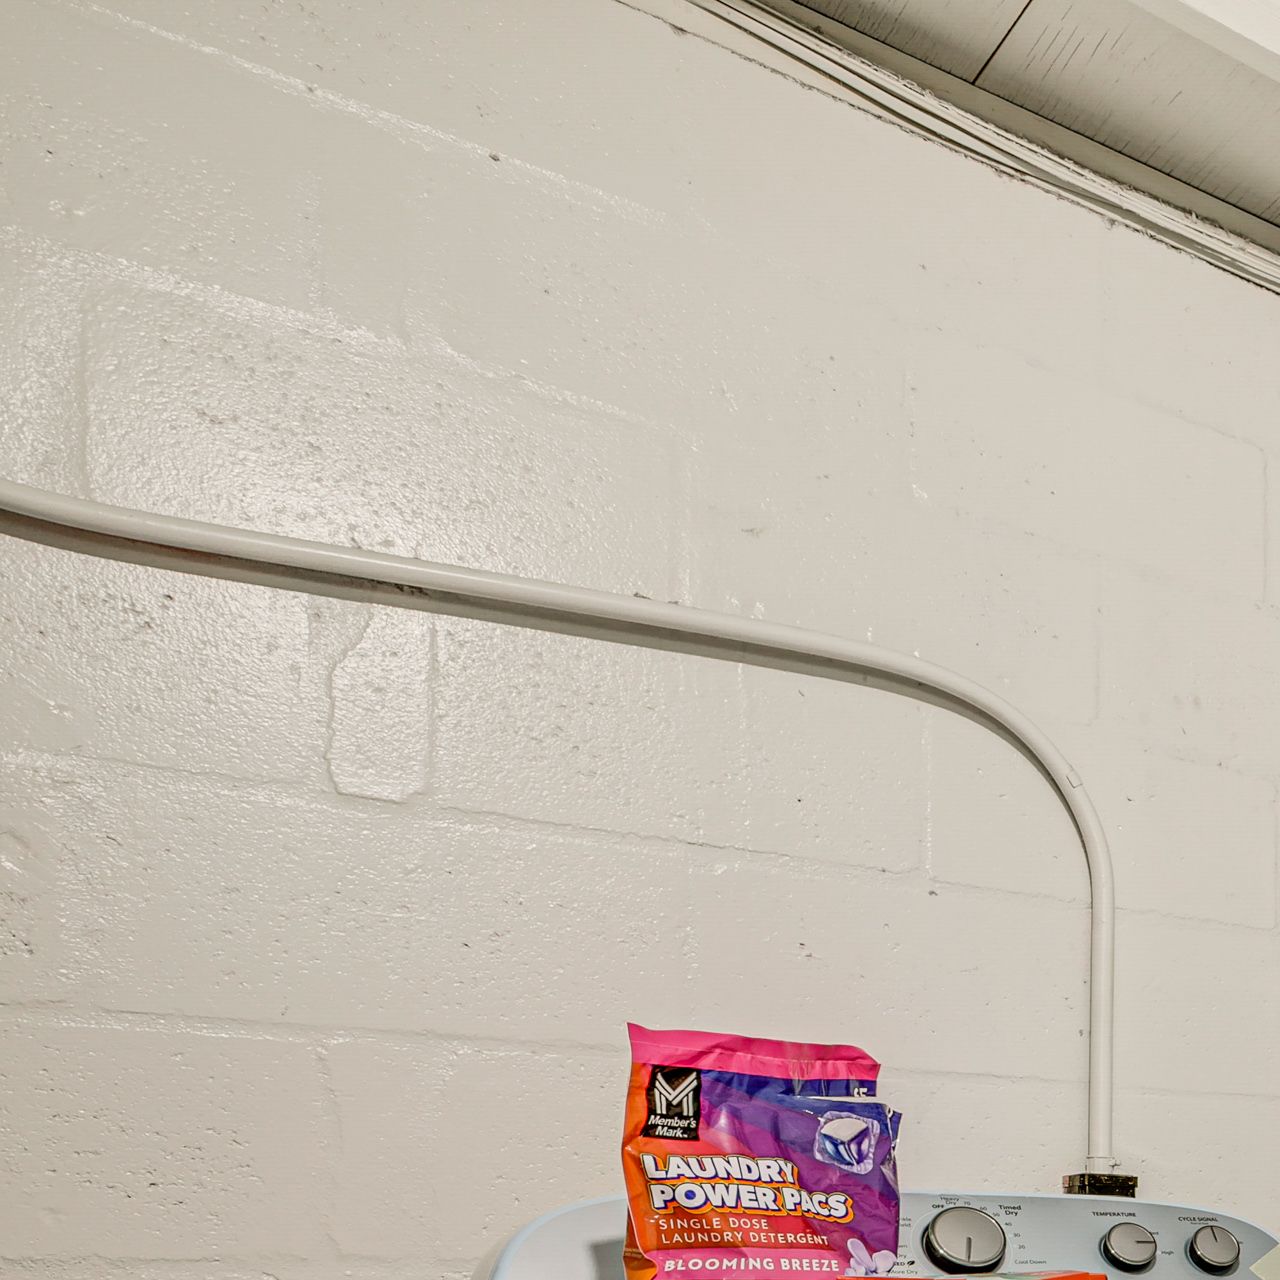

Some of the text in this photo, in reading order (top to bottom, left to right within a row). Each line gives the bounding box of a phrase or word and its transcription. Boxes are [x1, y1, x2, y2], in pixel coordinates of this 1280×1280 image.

[648, 1115, 697, 1129] Member's
[641, 1154, 798, 1184] LAUNDRY
[650, 1183, 849, 1219] POWER PACS
[659, 1217, 769, 1230] SINGLE DOSE
[661, 1231, 829, 1246] LAUNDRY DETERGENT
[664, 1258, 840, 1272] BLOOMING BREEZE
